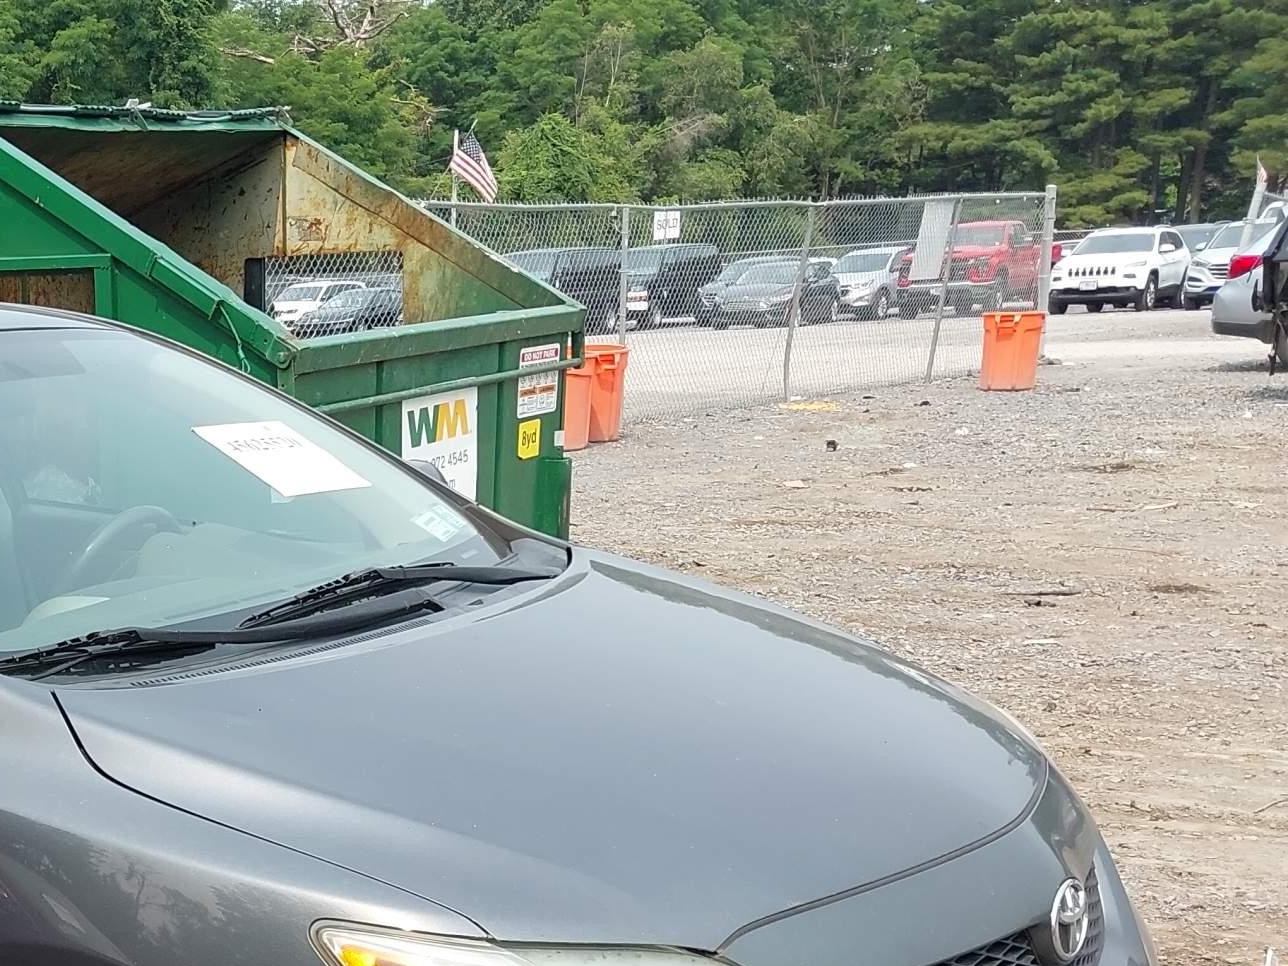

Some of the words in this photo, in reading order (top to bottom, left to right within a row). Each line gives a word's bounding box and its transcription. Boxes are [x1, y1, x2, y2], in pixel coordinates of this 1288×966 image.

[656, 217, 679, 231] SOLD
[523, 353, 532, 362] DO
[532, 351, 543, 360] NOT
[407, 399, 469, 448] WM
[521, 430, 537, 449] 8yd
[447, 449, 469, 465] 4545
